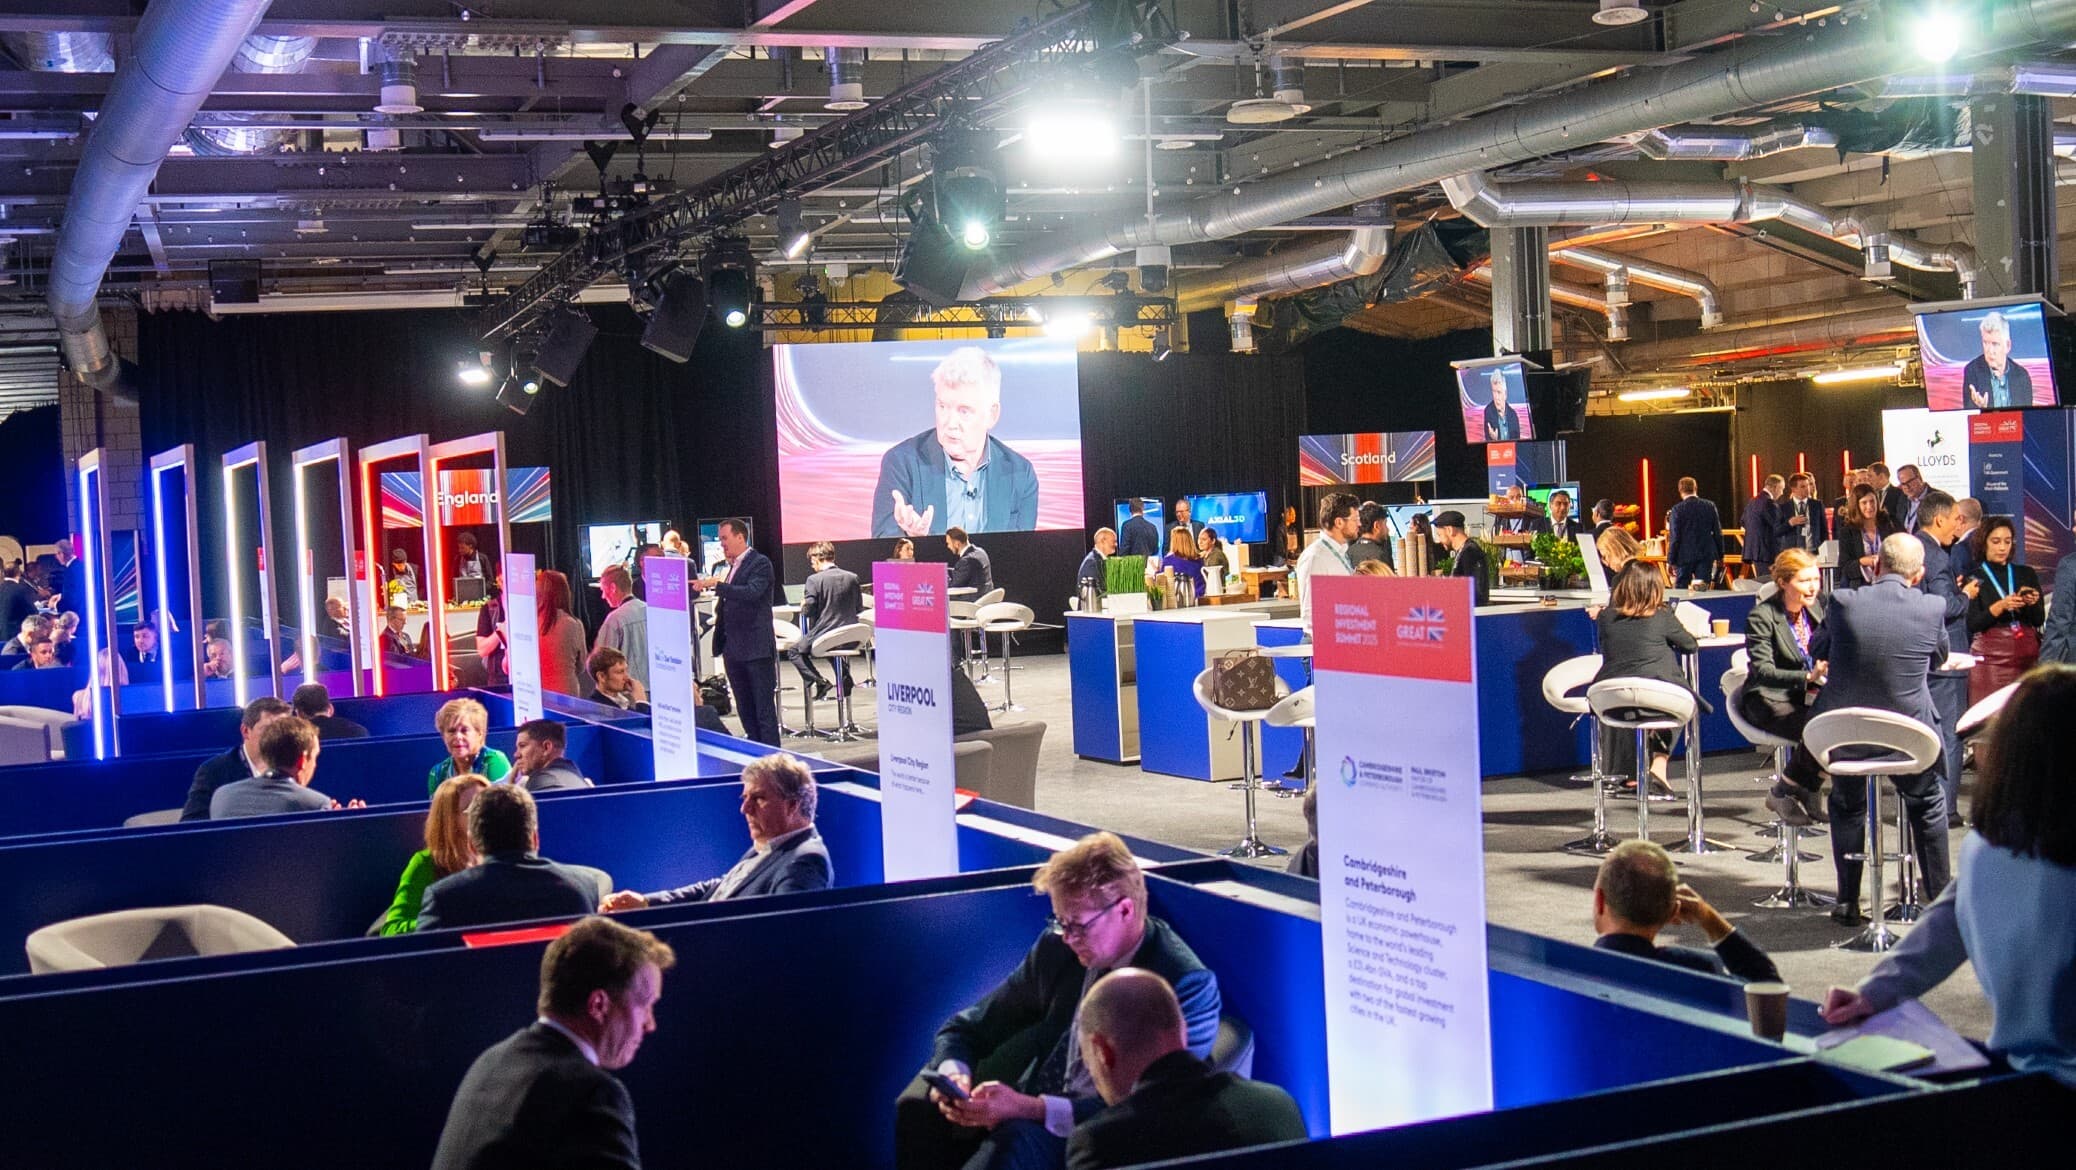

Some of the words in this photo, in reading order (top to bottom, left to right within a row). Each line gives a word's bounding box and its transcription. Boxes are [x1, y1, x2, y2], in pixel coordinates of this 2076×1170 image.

[1341, 451, 1396, 466] Scotland
[1917, 455, 1956, 467] LLOYDS
[438, 489, 499, 508] England
[1396, 624, 1425, 640] GREAT
[887, 682, 936, 708] LIVERPOOL
[1344, 854, 1407, 880] Cambridgeshire
[1345, 876, 1359, 888] and
[1361, 877, 1416, 903] Peterborough
[1346, 897, 1394, 918] Cambridgeshire
[1396, 912, 1409, 922] and
[1411, 912, 1457, 936] Peterborough
[1368, 920, 1399, 936] economic
[1346, 928, 1363, 941] home
[1409, 944, 1433, 962] leading
[1347, 941, 1369, 958] Science
[1372, 951, 1384, 962] and
[1385, 952, 1422, 974] Technology
[1349, 973, 1381, 991] destination
[1394, 988, 1415, 1003] global
[1417, 995, 1454, 1013] investment
[1418, 1011, 1446, 1029] growing
